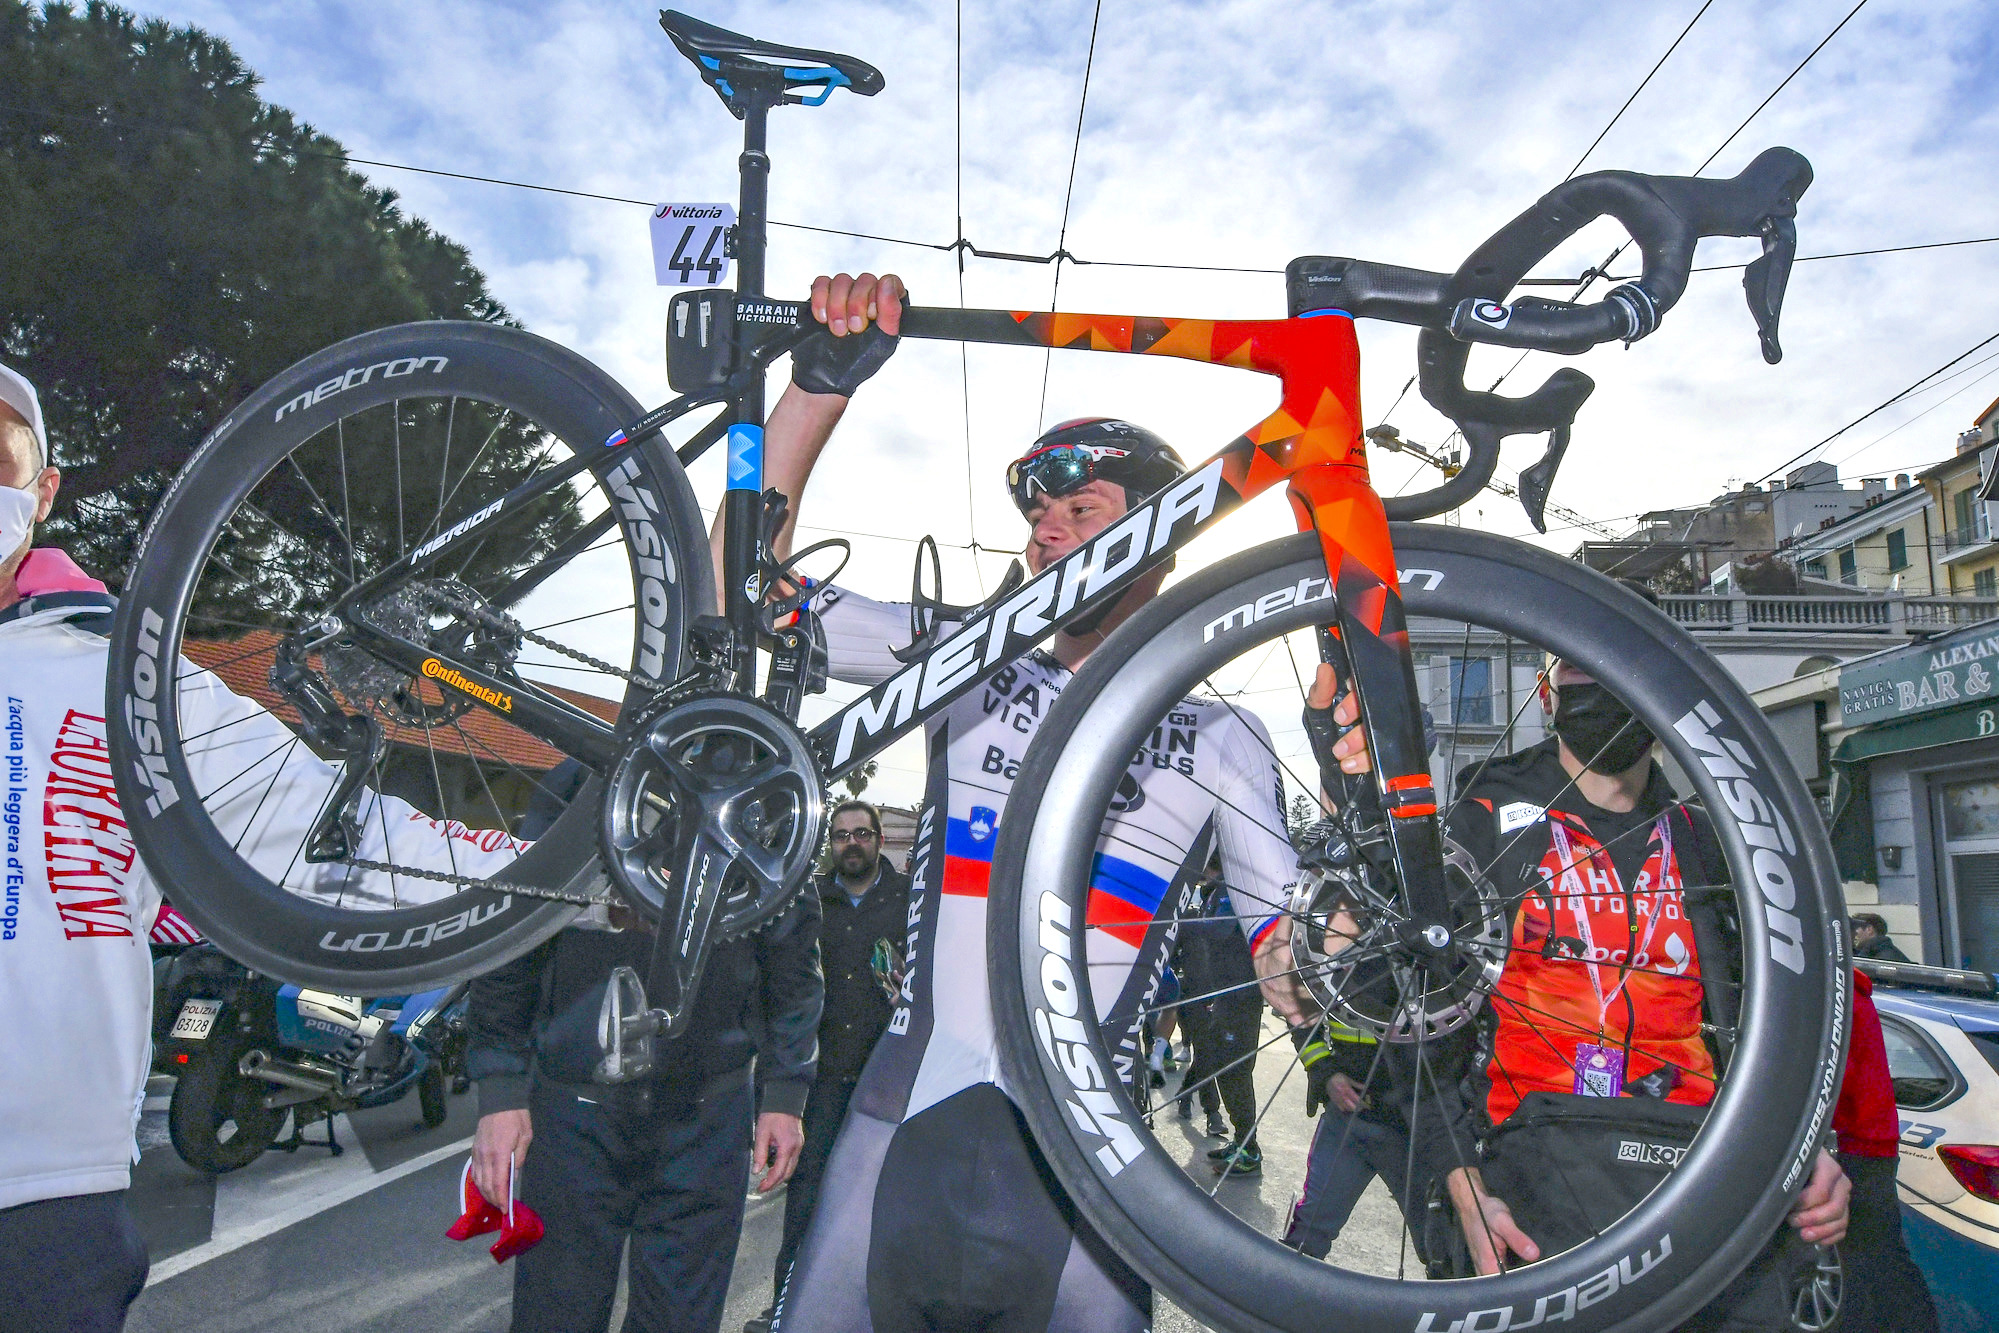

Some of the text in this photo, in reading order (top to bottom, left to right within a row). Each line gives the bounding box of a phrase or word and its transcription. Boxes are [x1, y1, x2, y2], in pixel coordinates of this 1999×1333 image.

[671, 207, 723, 219] vittoria
[668, 225, 724, 284] 44
[736, 313, 797, 325] VICTORIOUS
[737, 303, 798, 317] BAHRAIN
[275, 355, 449, 422] metron
[410, 498, 505, 567] MERIDA
[831, 457, 1224, 770] MERIDA
[421, 658, 504, 708] Continental
[1843, 679, 1894, 702] NAVIGA
[1843, 692, 1895, 716] GRATIS
[1895, 662, 1992, 711] BAR &
[1976, 709, 1996, 736] B
[5, 751, 29, 784] più
[4, 786, 28, 853] leggera
[43, 708, 135, 942] LAURETANA
[2, 853, 24, 942] d'Europa
[319, 894, 512, 955] metron
[888, 804, 936, 1037] BAHRAIN
[182, 1005, 218, 1015] POLIZIA
[1830, 966, 1846, 1047] GRAND
[1800, 1097, 1832, 1164] 5000
[1414, 1233, 1673, 1333] metron
